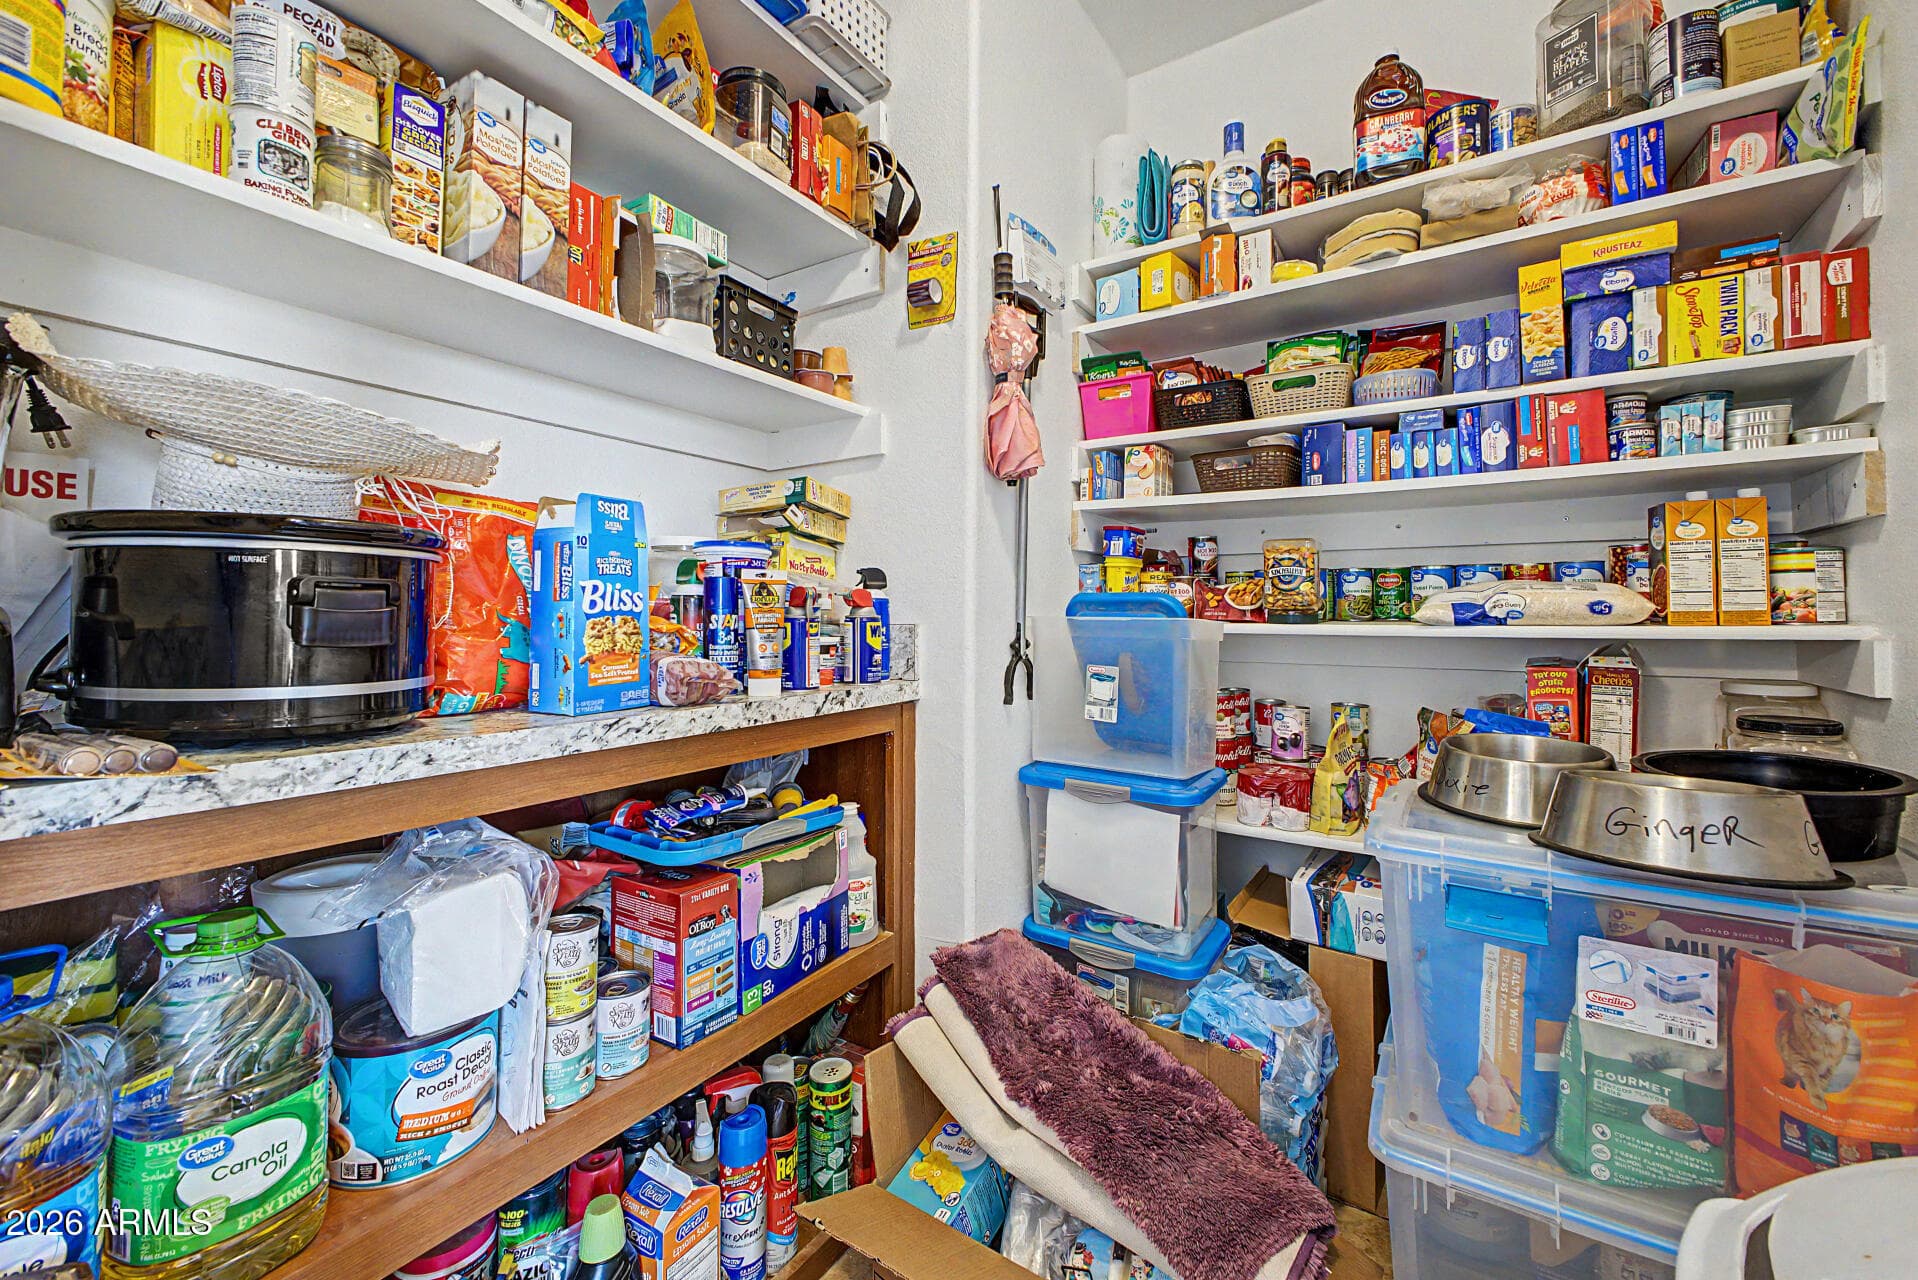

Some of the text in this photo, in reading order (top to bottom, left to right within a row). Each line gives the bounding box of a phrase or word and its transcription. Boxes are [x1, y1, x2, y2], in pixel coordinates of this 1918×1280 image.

[284, 3, 337, 36] PECAN
[210, 62, 225, 103] Lipton
[1369, 111, 1415, 129] CRANBERRY
[1427, 103, 1480, 134] PLANTERS
[476, 136, 517, 163] Potatoes
[478, 127, 518, 153] Mashed
[527, 161, 567, 187] Potatoes
[530, 154, 567, 178] Mashed
[244, 178, 283, 195] BAKING
[1592, 240, 1643, 258] KRUSTEAZ
[1720, 276, 1739, 337] TWIN PACK
[1613, 401, 1646, 409] ARMOUR
[1622, 429, 1655, 437] ARMOUR
[597, 501, 631, 520] Bliss
[576, 535, 588, 546] 10
[228, 554, 268, 564] HOT SURFACE
[788, 559, 829, 577] Nutty Buddy
[598, 564, 633, 578] TREATS
[561, 564, 574, 601] Bliss
[579, 579, 645, 615] Bliss
[1602, 602, 1610, 614] 5
[1532, 671, 1568, 679] TRY OUR
[1538, 679, 1564, 687] OTHER
[1592, 674, 1633, 687] Cheerios
[1530, 687, 1574, 697] PRODUCTS!
[773, 918, 783, 961] Strong
[1500, 971, 1509, 993] LESS
[747, 988, 760, 1008] 13
[1508, 956, 1521, 1054] HEALTHY WEIGHT
[1591, 991, 1633, 1008] Sterilite
[414, 1054, 446, 1069] Great
[455, 1041, 492, 1071] Classic
[416, 1049, 492, 1100] Roast Decaf
[421, 1062, 446, 1074] Value
[442, 1081, 472, 1102] Ground
[1594, 1069, 1672, 1097] GOURMET
[402, 1112, 452, 1130] MEDIUM
[145, 1125, 226, 1158] FRYING
[184, 1139, 226, 1161] Great
[936, 1140, 955, 1153] Duster
[956, 1136, 977, 1149] 360
[194, 1149, 226, 1165] Value
[211, 1140, 289, 1182] Canola
[262, 1154, 288, 1178] Oil
[641, 1182, 671, 1206] Rexall
[720, 1187, 764, 1219] RESOLVE
[773, 1188, 787, 1201] Ant
[236, 1180, 309, 1232] FRYING
[677, 1206, 708, 1240] Rexall
[625, 1221, 656, 1252] Rexall
[672, 1222, 710, 1259] Epsom Salt
